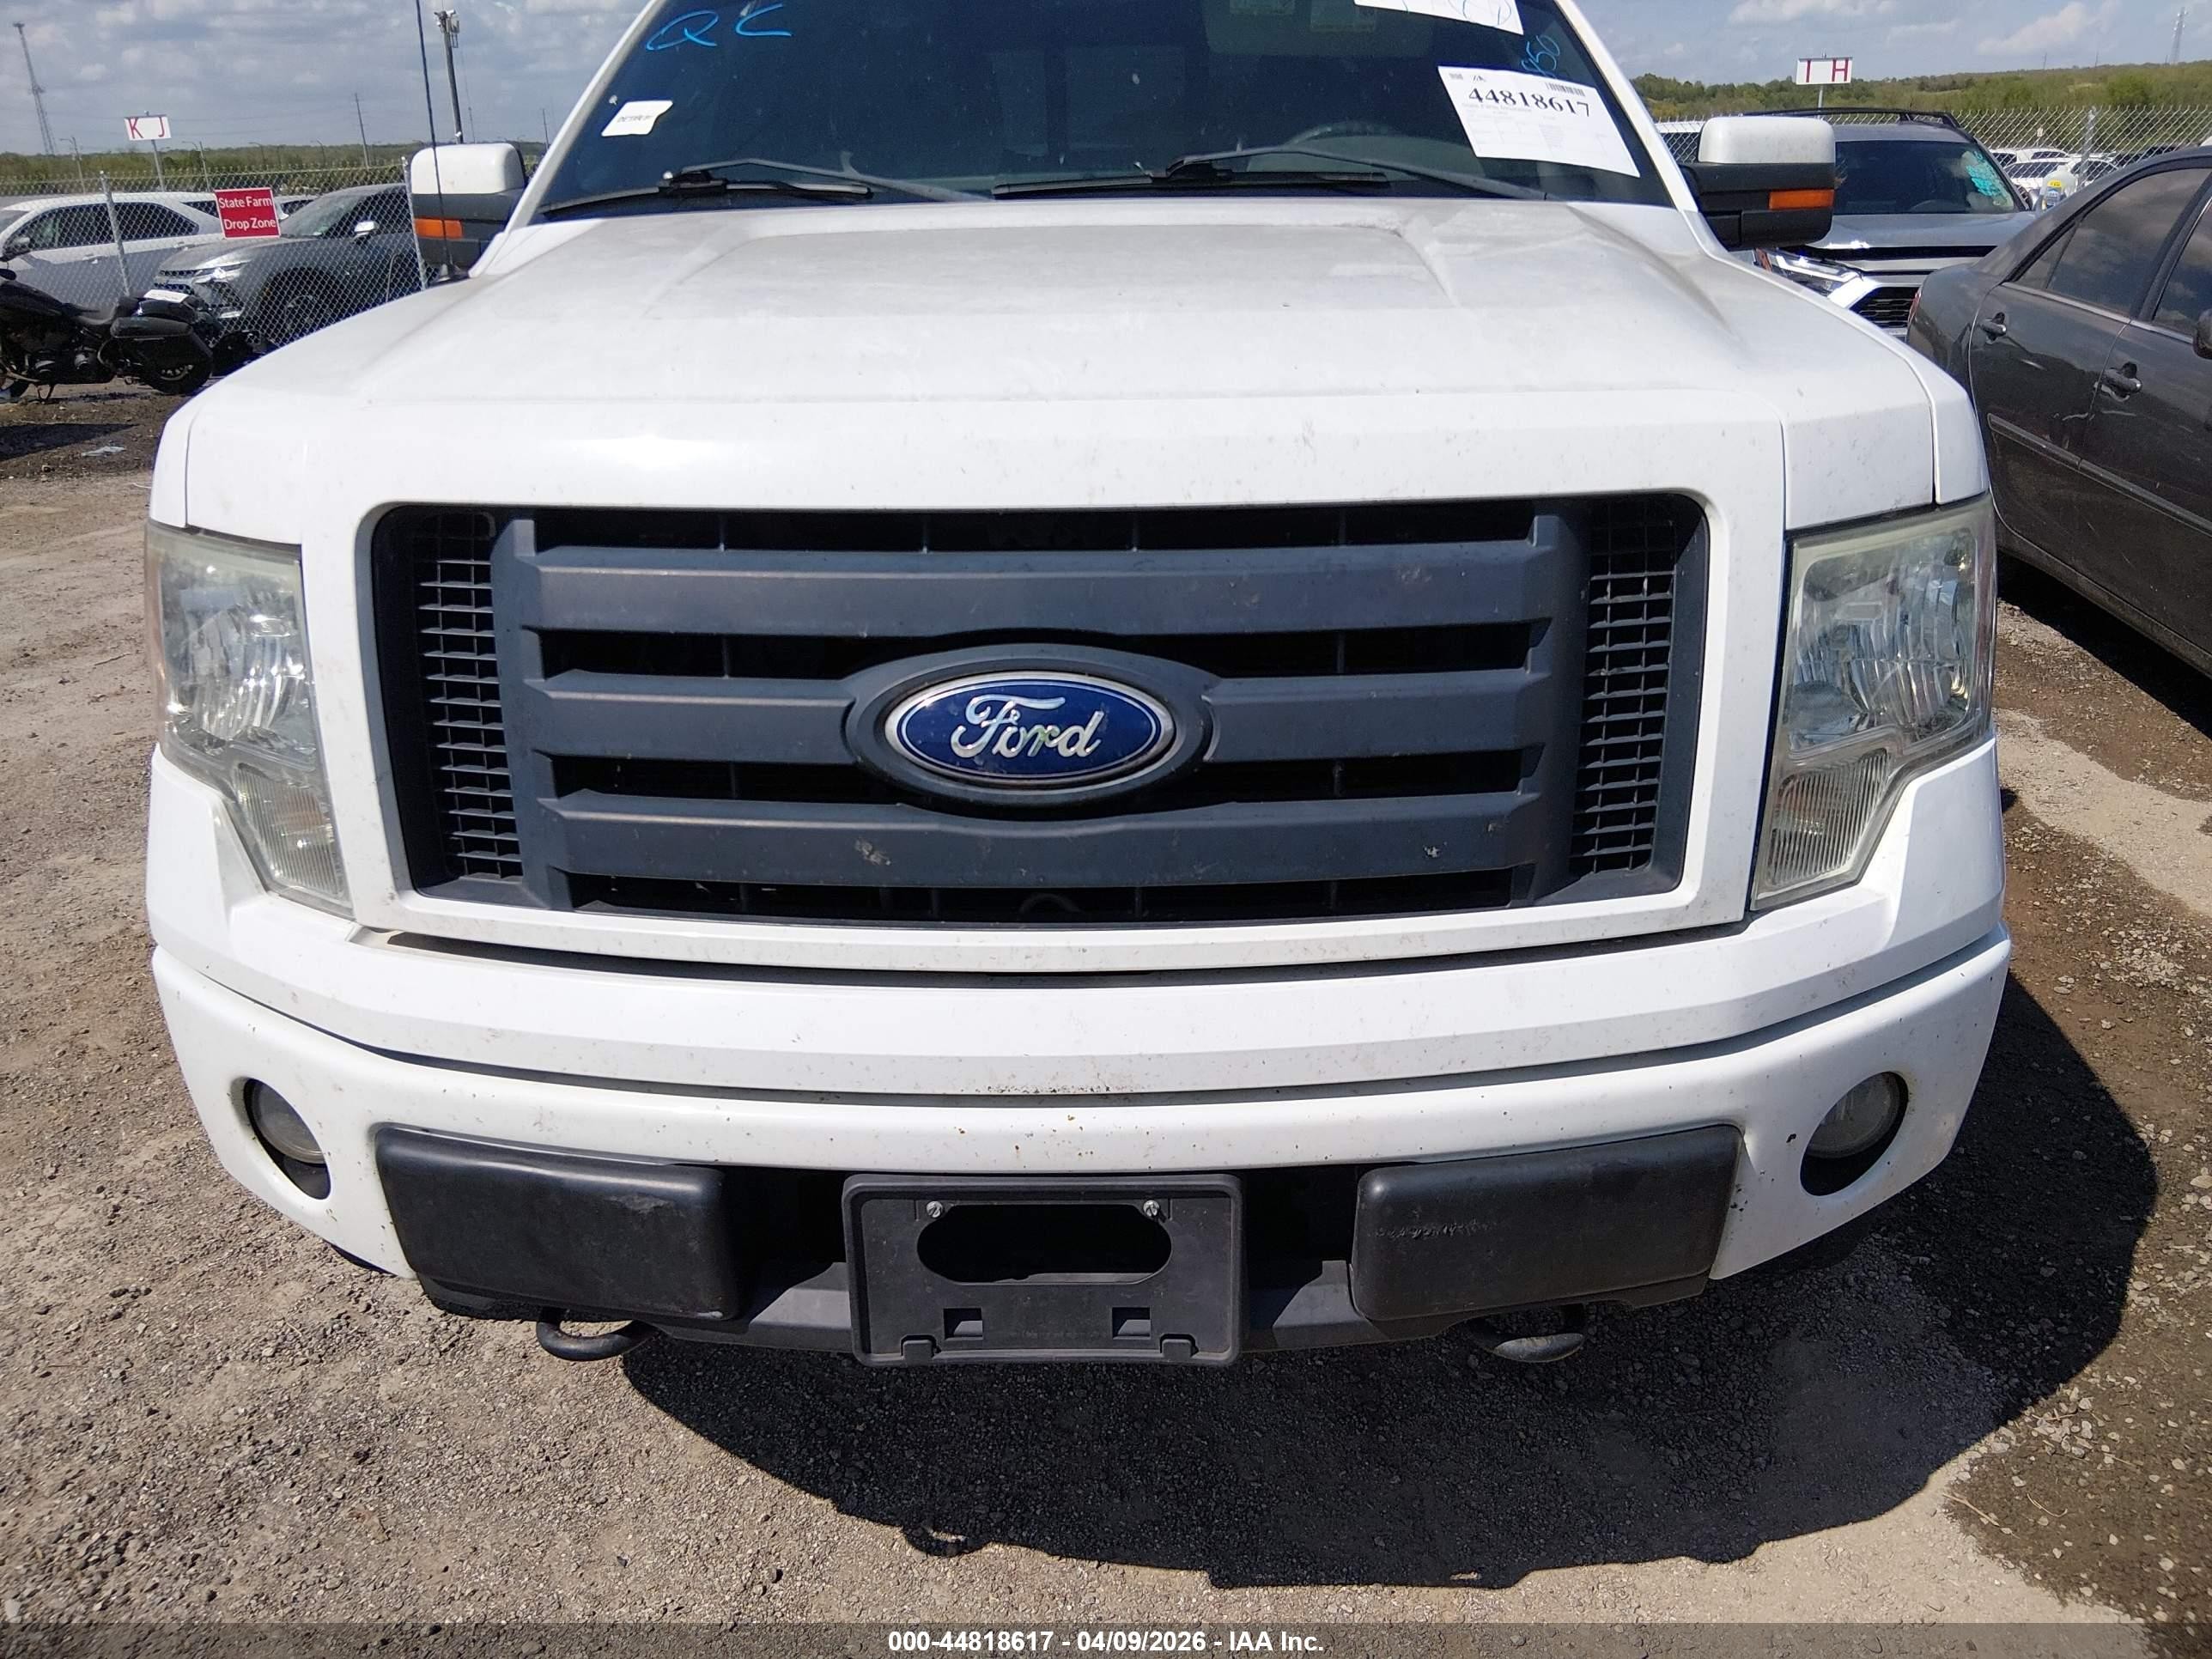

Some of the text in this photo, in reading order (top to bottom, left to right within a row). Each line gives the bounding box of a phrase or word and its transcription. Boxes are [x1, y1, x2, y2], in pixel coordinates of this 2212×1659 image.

[1832, 59, 1850, 82] H
[1468, 88, 1589, 118] 44818617
[129, 117, 165, 139] K J
[219, 196, 272, 209] State Farm
[223, 217, 276, 231] Drop Zone
[950, 694, 1103, 758] Ford
